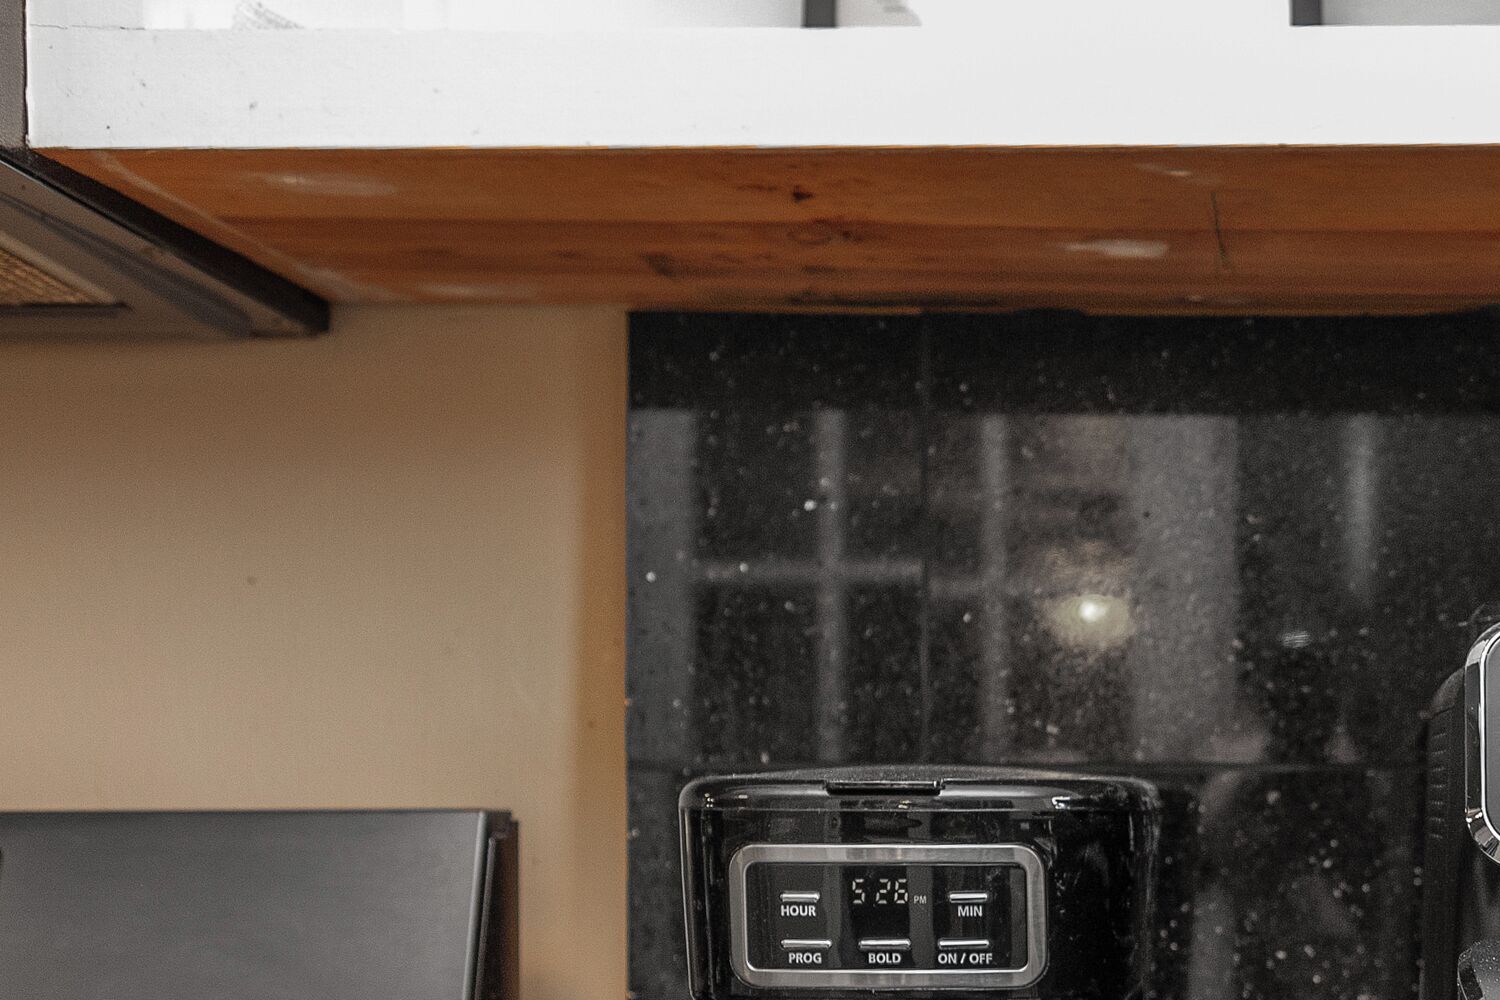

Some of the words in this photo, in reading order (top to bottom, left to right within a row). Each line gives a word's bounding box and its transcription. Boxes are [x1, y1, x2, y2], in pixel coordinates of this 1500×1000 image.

[913, 895, 927, 904] PM
[780, 905, 816, 917] HOUR
[957, 906, 983, 917] MIN
[788, 953, 822, 964] PROG
[868, 953, 901, 964] BOLD
[938, 953, 957, 964] ON
[969, 953, 993, 964] OFF
